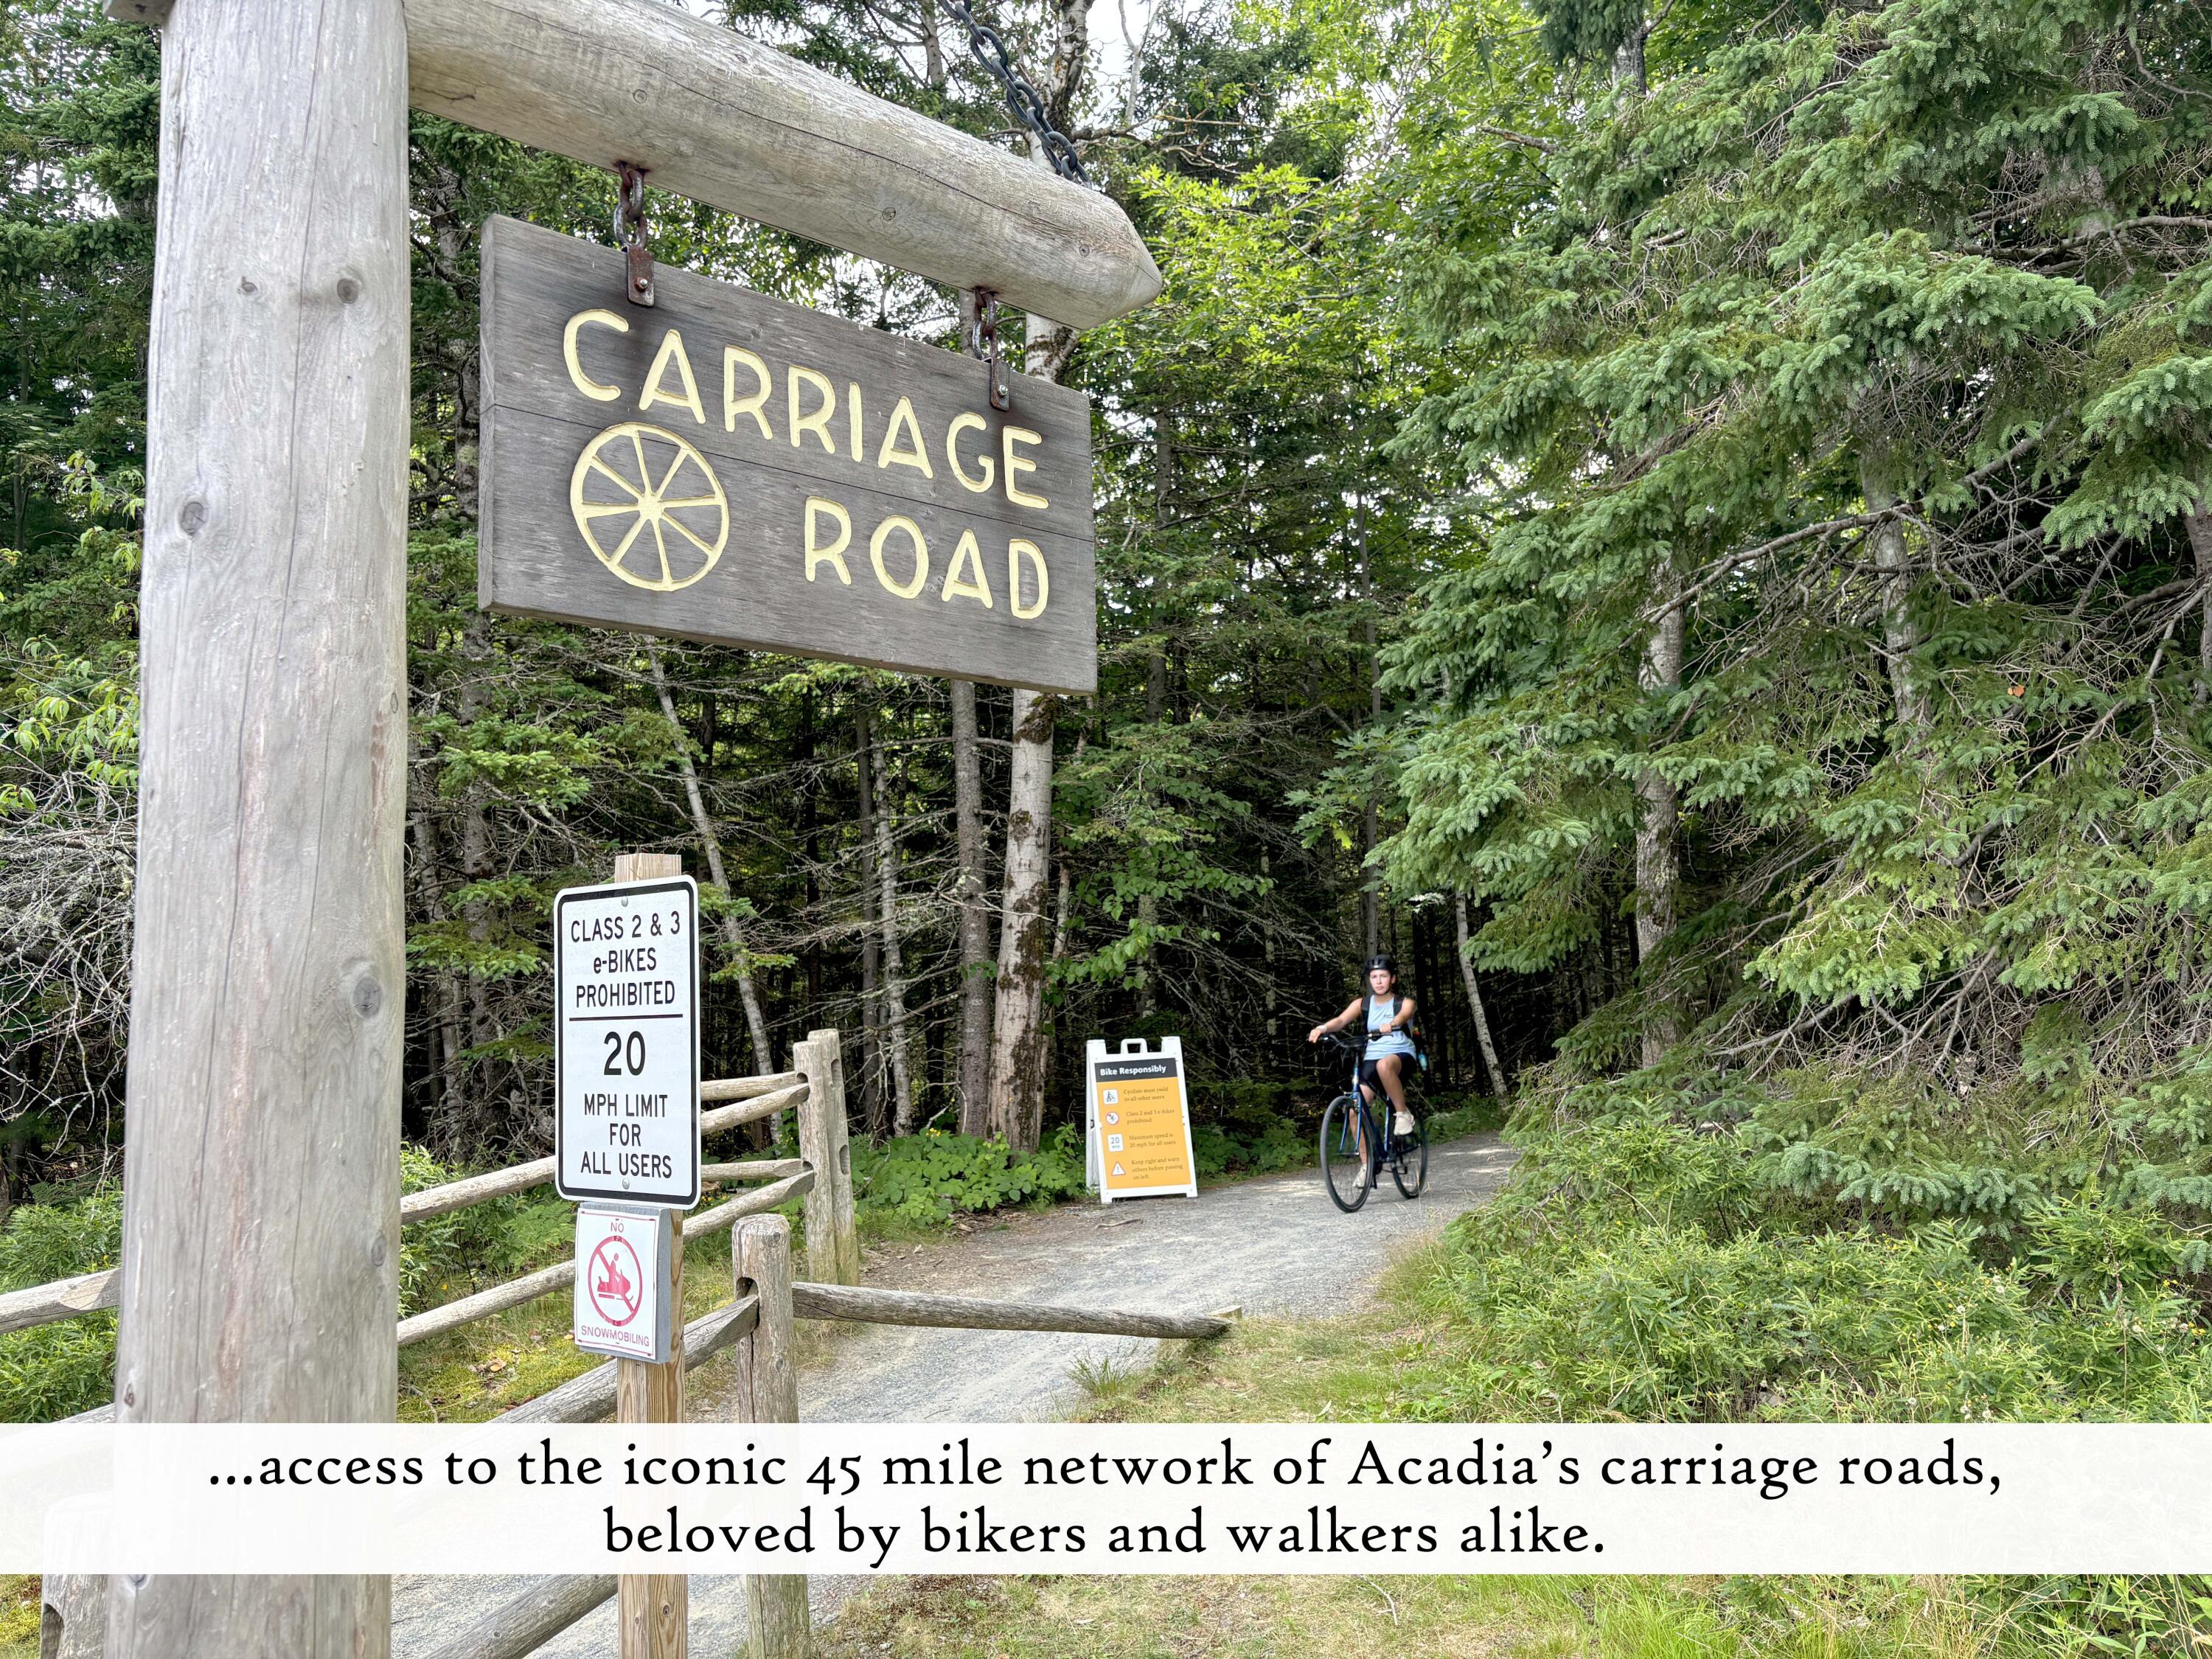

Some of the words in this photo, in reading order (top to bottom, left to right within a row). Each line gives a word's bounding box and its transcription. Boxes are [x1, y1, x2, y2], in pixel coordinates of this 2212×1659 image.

[563, 308, 1050, 509] CARRIAGE
[804, 496, 1050, 619] ROAD
[571, 915, 624, 943] CLASS
[631, 914, 642, 939] 2
[650, 912, 662, 936] &
[670, 911, 681, 935] 3
[593, 947, 656, 974] e-BIKES
[576, 980, 675, 1008] PROHIBITED
[603, 1030, 646, 1076] 20
[1119, 1065, 1166, 1075] Responsibly
[584, 1093, 617, 1116] MPH
[625, 1093, 668, 1118] LIMIT
[609, 1123, 641, 1147] FOR
[1110, 1136, 1119, 1144] 20
[580, 1151, 611, 1175] ALL
[619, 1152, 672, 1179] USERS
[610, 1221, 625, 1234] NO
[581, 1324, 650, 1347] SNOWMOBILING
